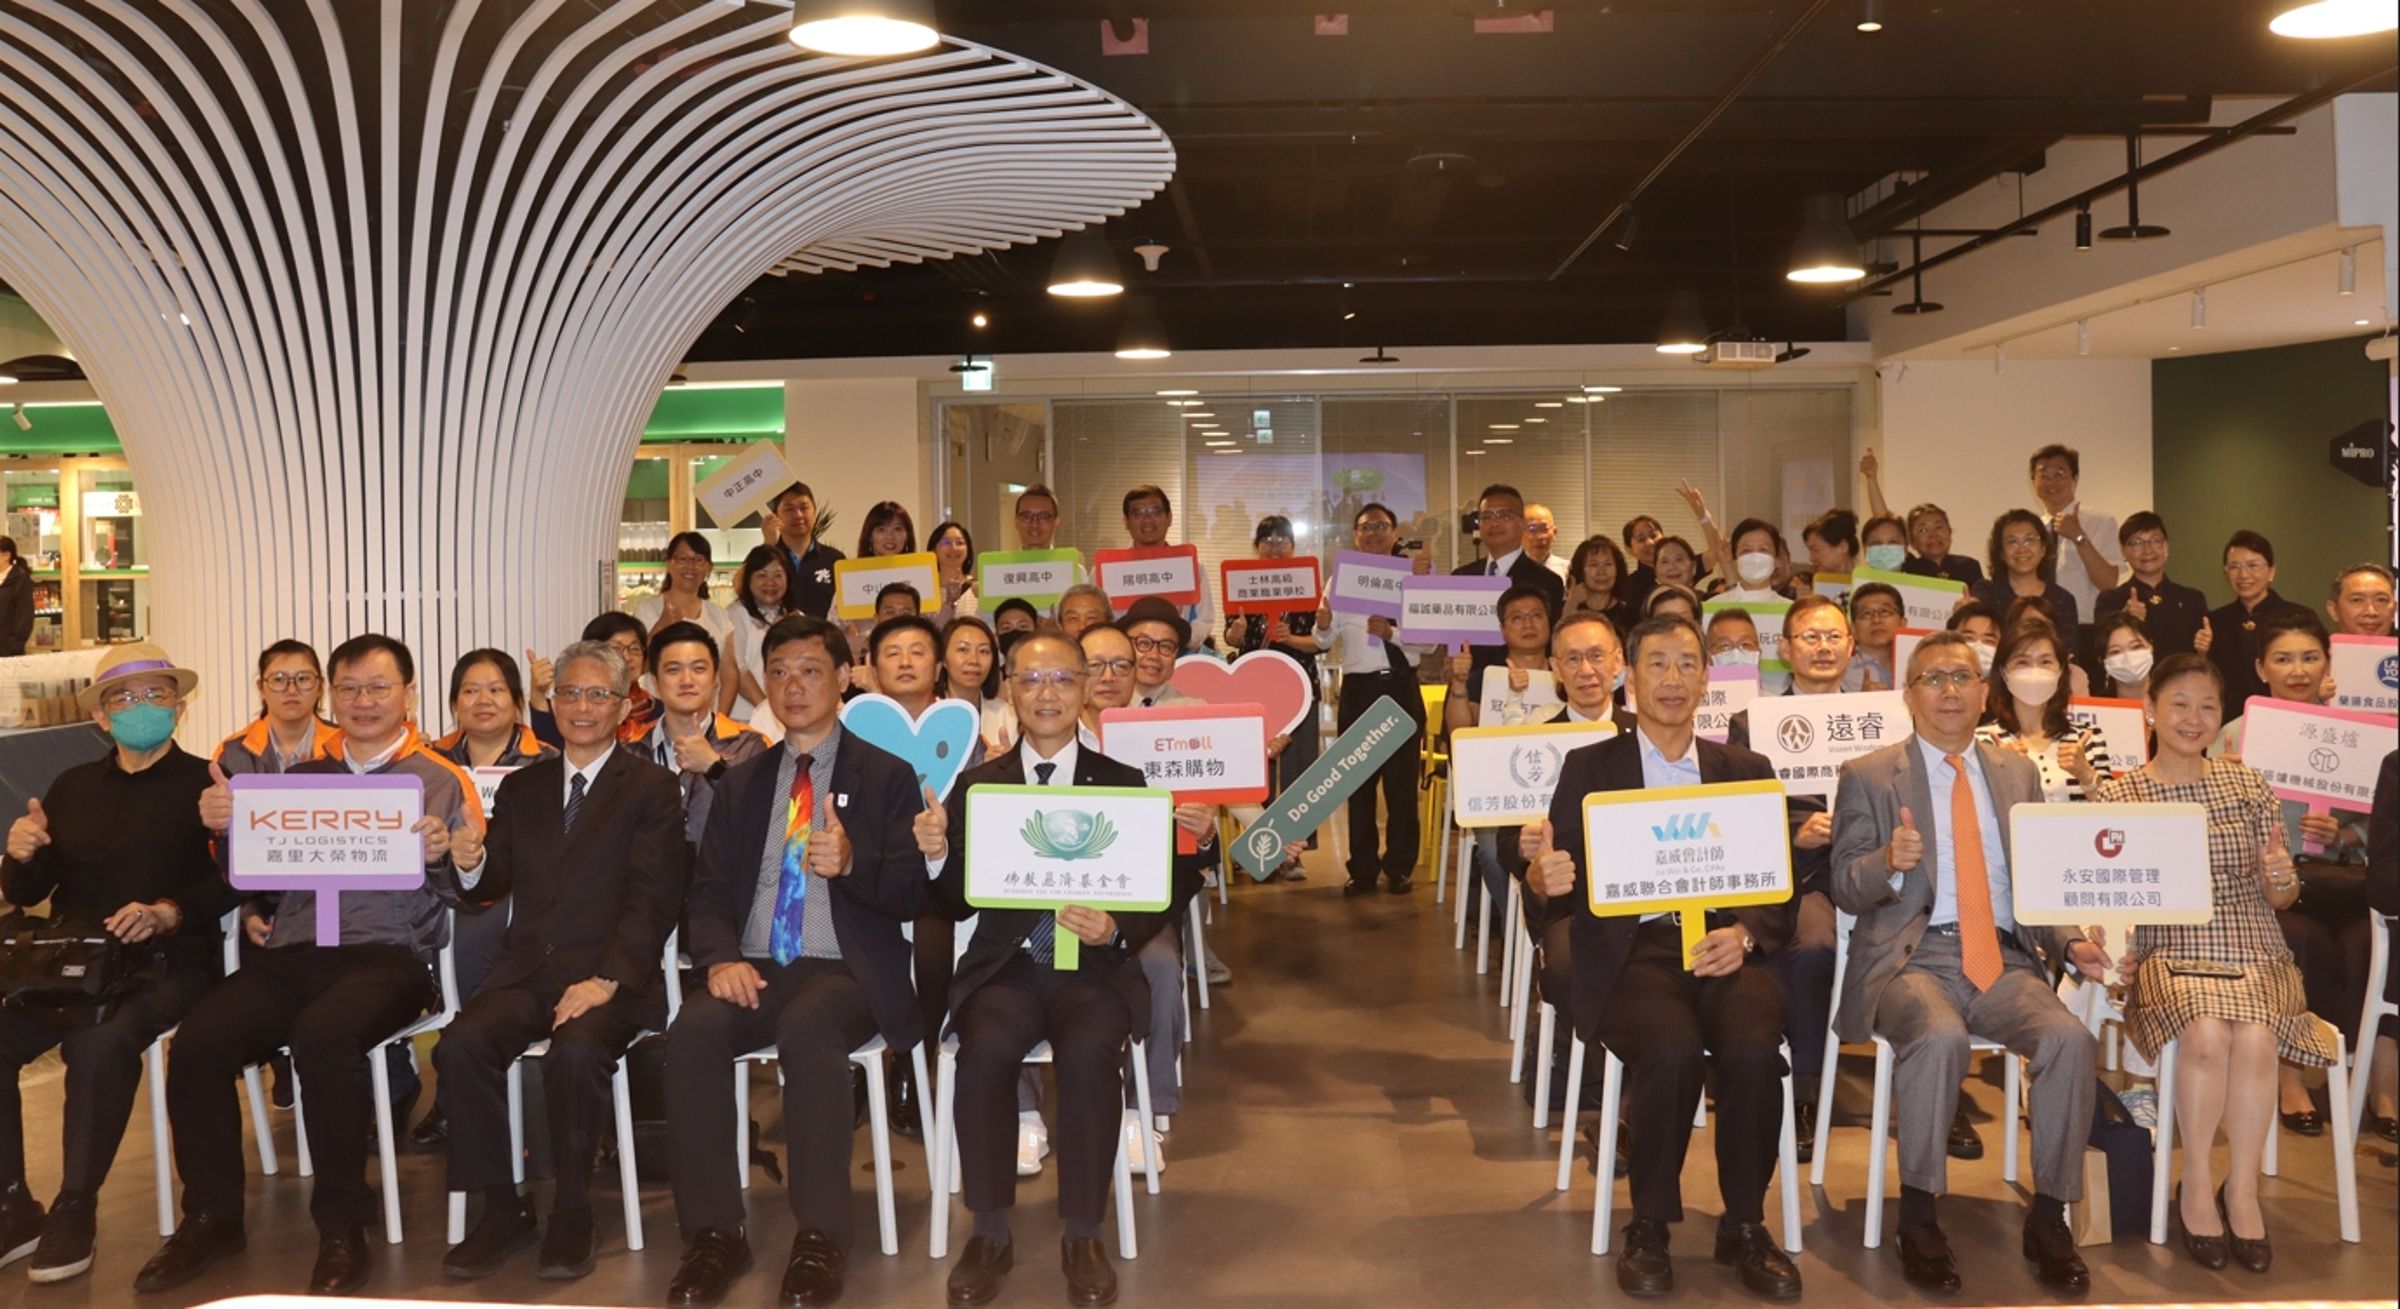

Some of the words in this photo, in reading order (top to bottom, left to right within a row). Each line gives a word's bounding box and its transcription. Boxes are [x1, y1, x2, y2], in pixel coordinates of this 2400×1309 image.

[723, 468, 763, 498] 中正高中
[1003, 571, 1053, 585] 復興高中
[1122, 571, 1174, 586] 陽明高中
[1248, 573, 1293, 585] 士林高級
[1238, 586, 1305, 598] 商業職業學校
[1826, 712, 1884, 741] 遠睿
[2299, 722, 2360, 749] 源盛爐
[1143, 758, 1225, 780] 東森購物
[1287, 803, 1309, 823] Do
[1306, 767, 1342, 804] Good
[1337, 715, 1400, 772] Together.
[1525, 749, 1543, 782] 信芳
[250, 810, 403, 831] KERRY
[267, 836, 288, 845] TJ
[293, 836, 388, 845] LOGISTICS
[267, 849, 389, 863] 嘉里大榮物流
[1655, 847, 1725, 866] 嘉威會計師
[1004, 871, 1132, 889] 佛教慈濟基金會
[1605, 871, 1777, 899] 嘉威聯合會計師事務所
[2063, 868, 2161, 884] 永安國際管理
[2063, 891, 2162, 907] 顧問有限公司
